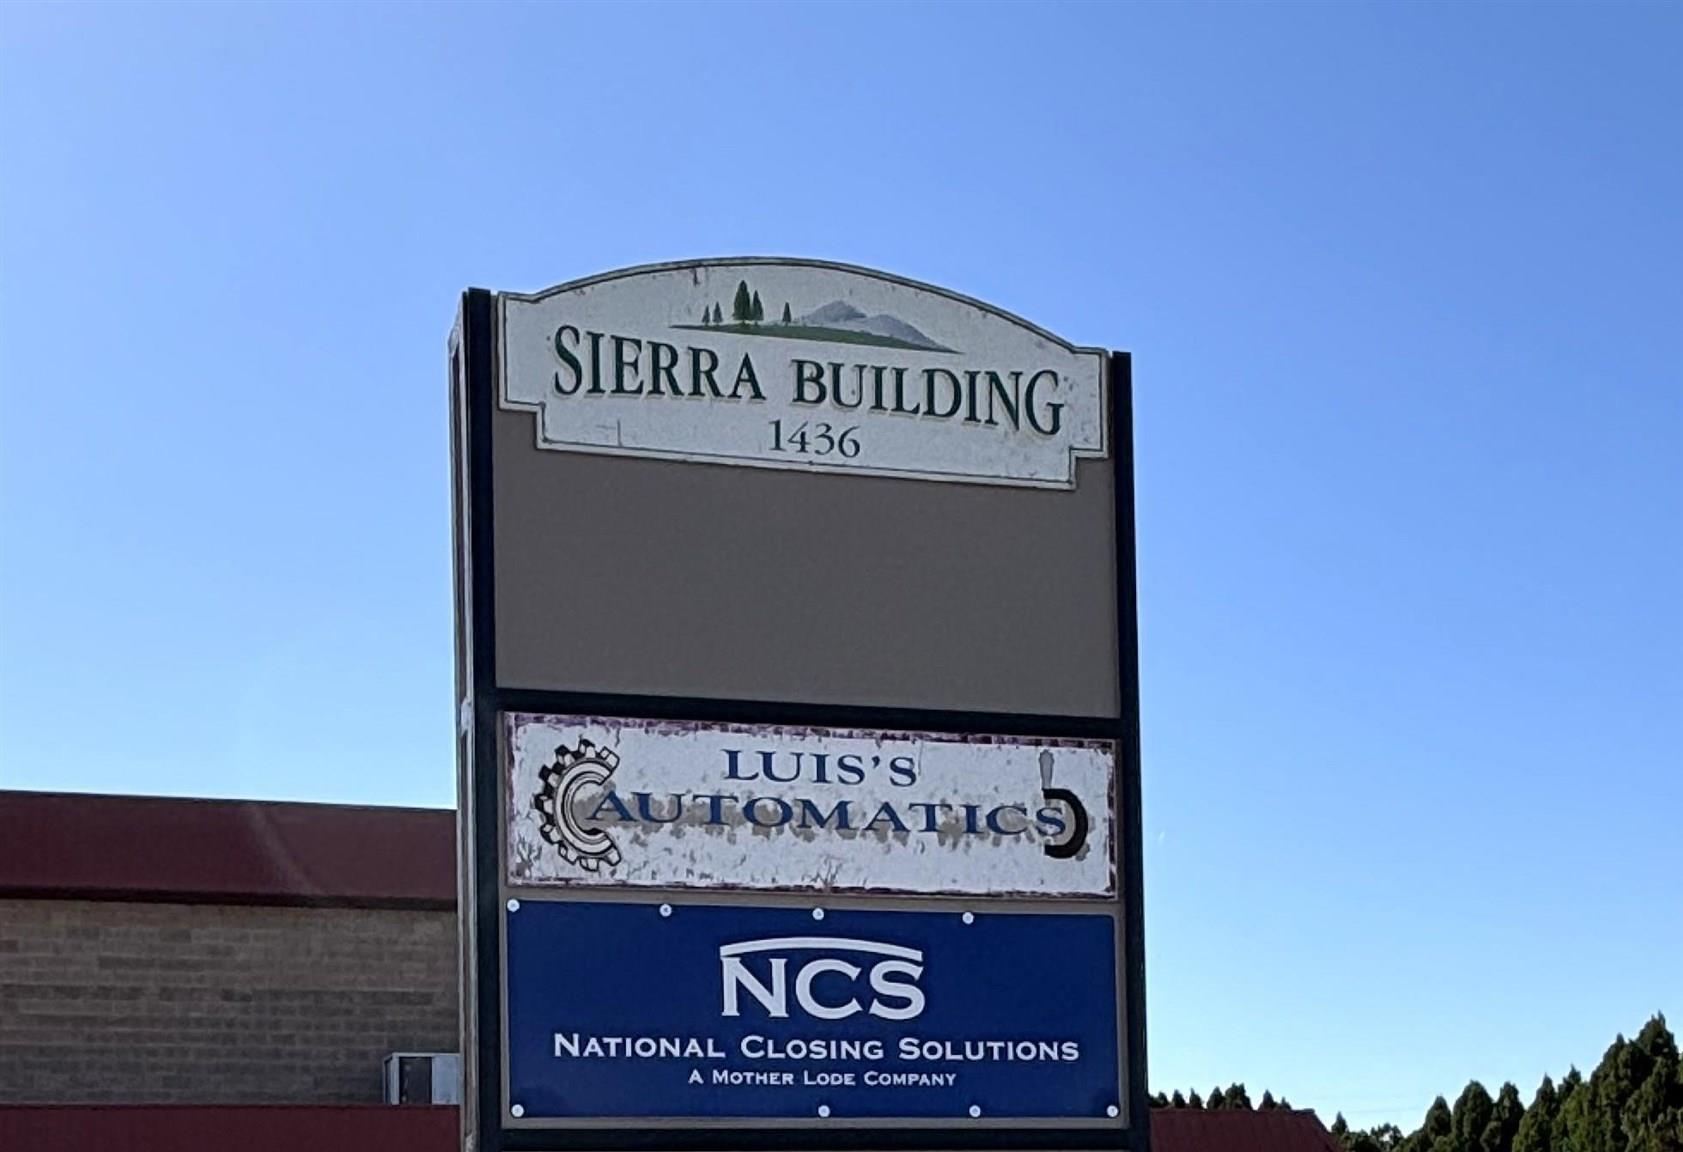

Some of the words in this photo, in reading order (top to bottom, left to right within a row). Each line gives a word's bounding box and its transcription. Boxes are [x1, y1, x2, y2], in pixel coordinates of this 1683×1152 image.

[553, 325, 766, 399] SIERRA
[791, 358, 1064, 435] BUILDING
[769, 420, 860, 458] 1436
[587, 790, 1067, 836] AUTOMATICS
[720, 956, 926, 1019] NCS
[553, 1032, 726, 1059] NATIONAL
[740, 1034, 884, 1061] CLOSING
[899, 1037, 1080, 1062] SOLUTIONS
[688, 1070, 704, 1085] A
[712, 1070, 794, 1087] MOTHER
[803, 1071, 856, 1087] LODE
[864, 1072, 957, 1088] COMPANY
